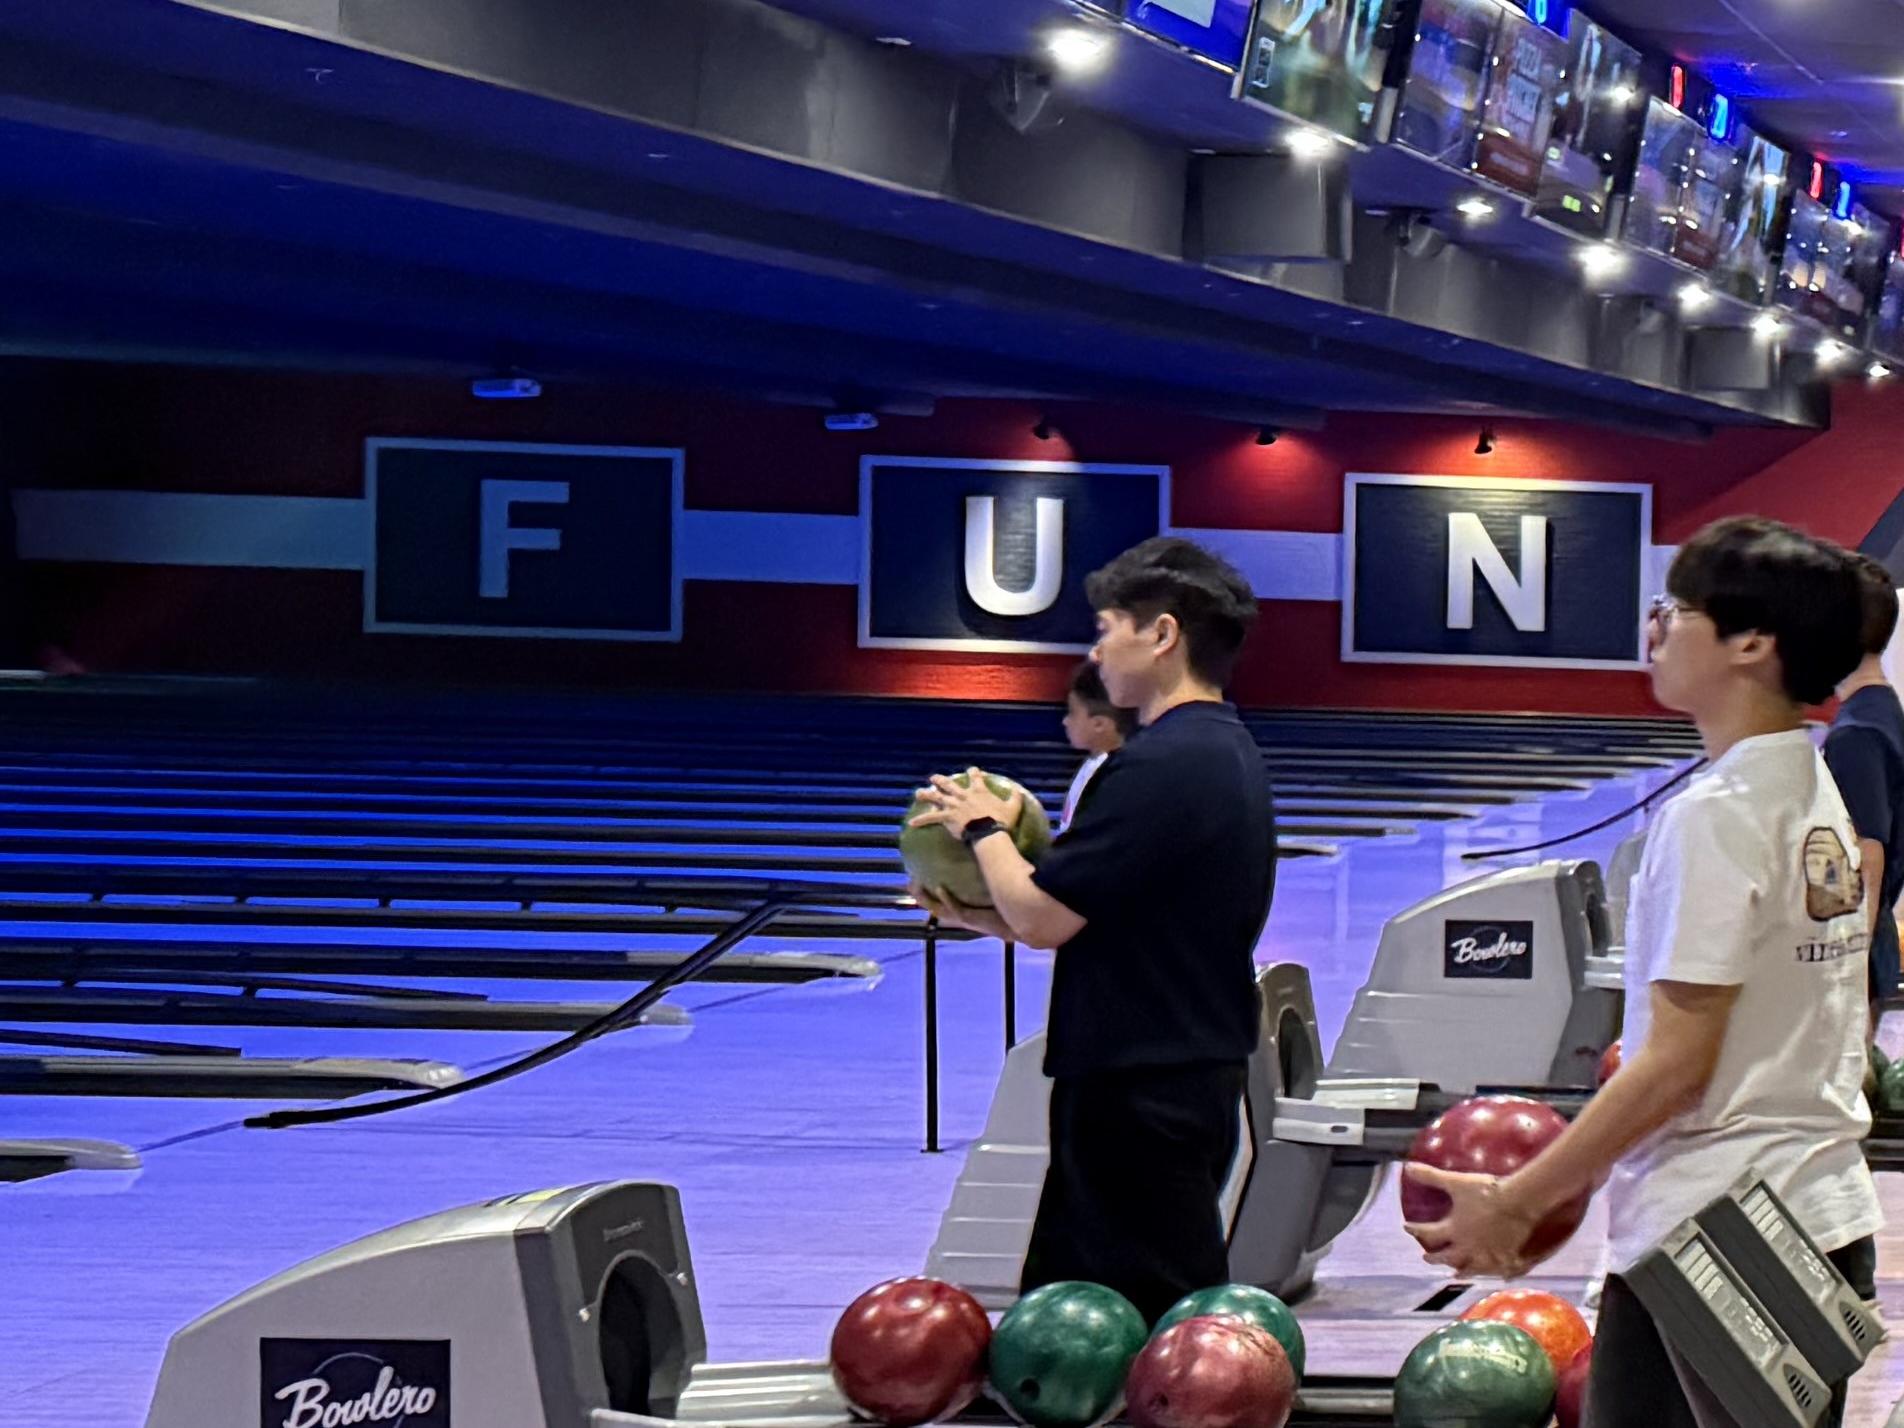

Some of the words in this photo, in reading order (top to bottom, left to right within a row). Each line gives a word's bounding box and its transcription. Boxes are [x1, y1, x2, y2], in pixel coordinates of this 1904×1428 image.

[479, 479, 570, 598] F
[964, 496, 1064, 616] U
[1446, 512, 1548, 633] N
[1450, 932, 1527, 963] Bowlero
